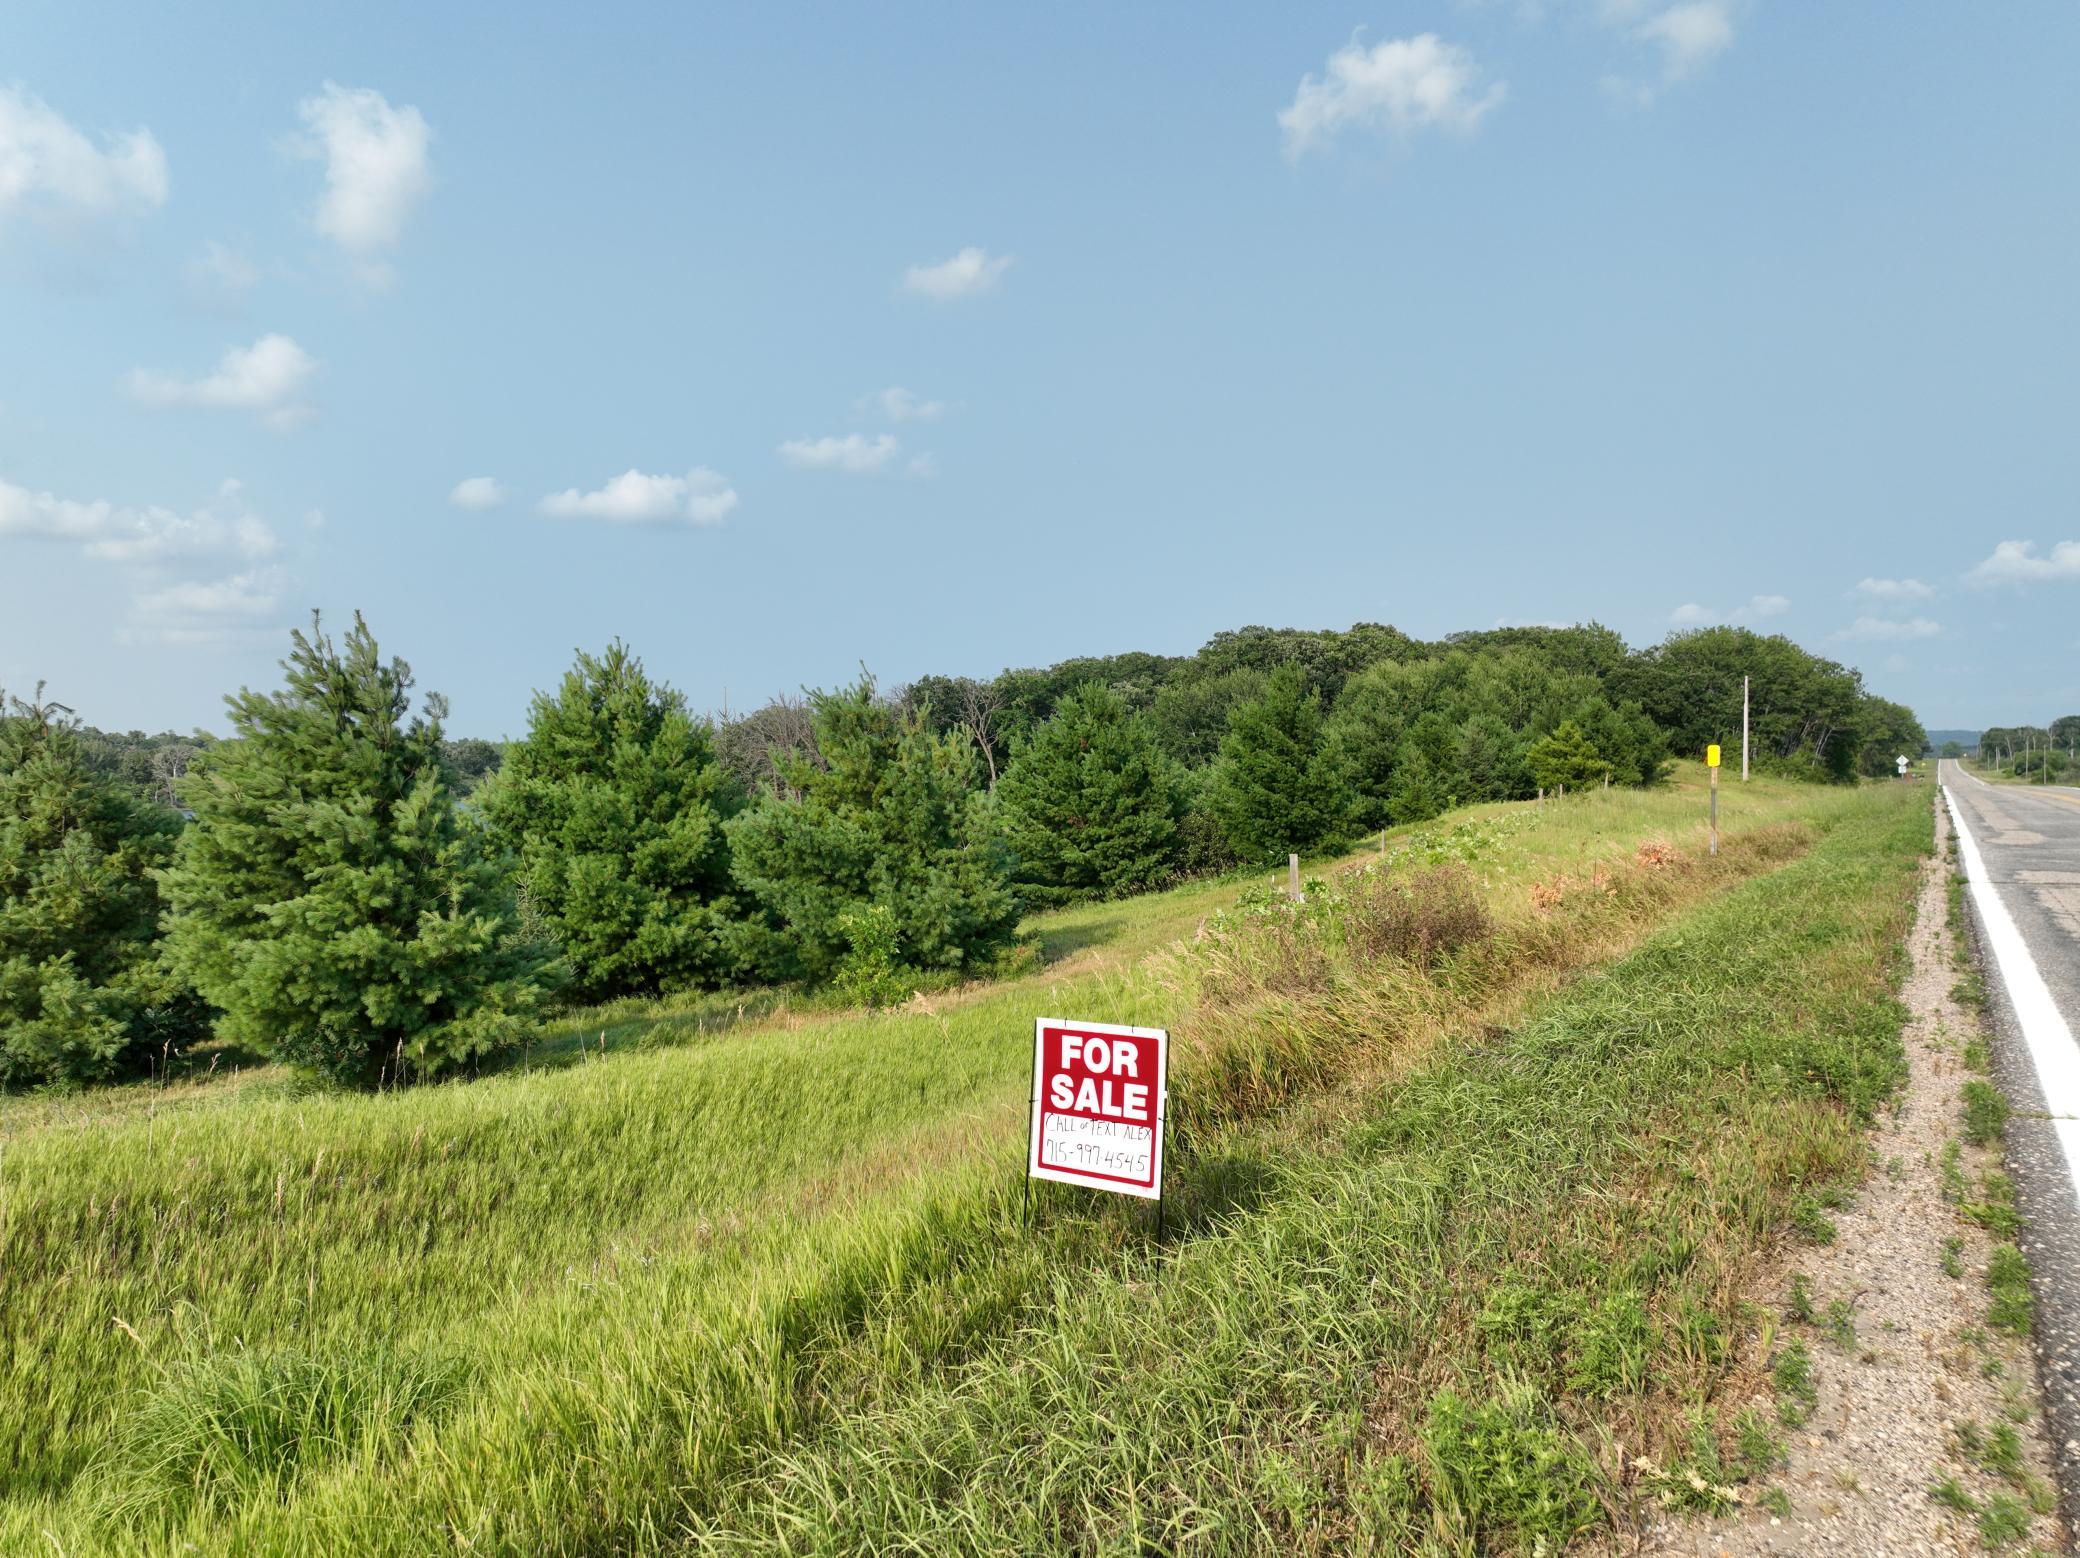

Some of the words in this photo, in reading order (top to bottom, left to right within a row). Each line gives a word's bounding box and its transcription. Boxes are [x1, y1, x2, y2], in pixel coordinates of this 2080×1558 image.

[1061, 1035, 1138, 1077] FOR
[1051, 1074, 1148, 1120] SALE
[1046, 1113, 1076, 1132] CALL
[1090, 1119, 1117, 1137] TEXT
[1124, 1125, 1152, 1141] ALEX
